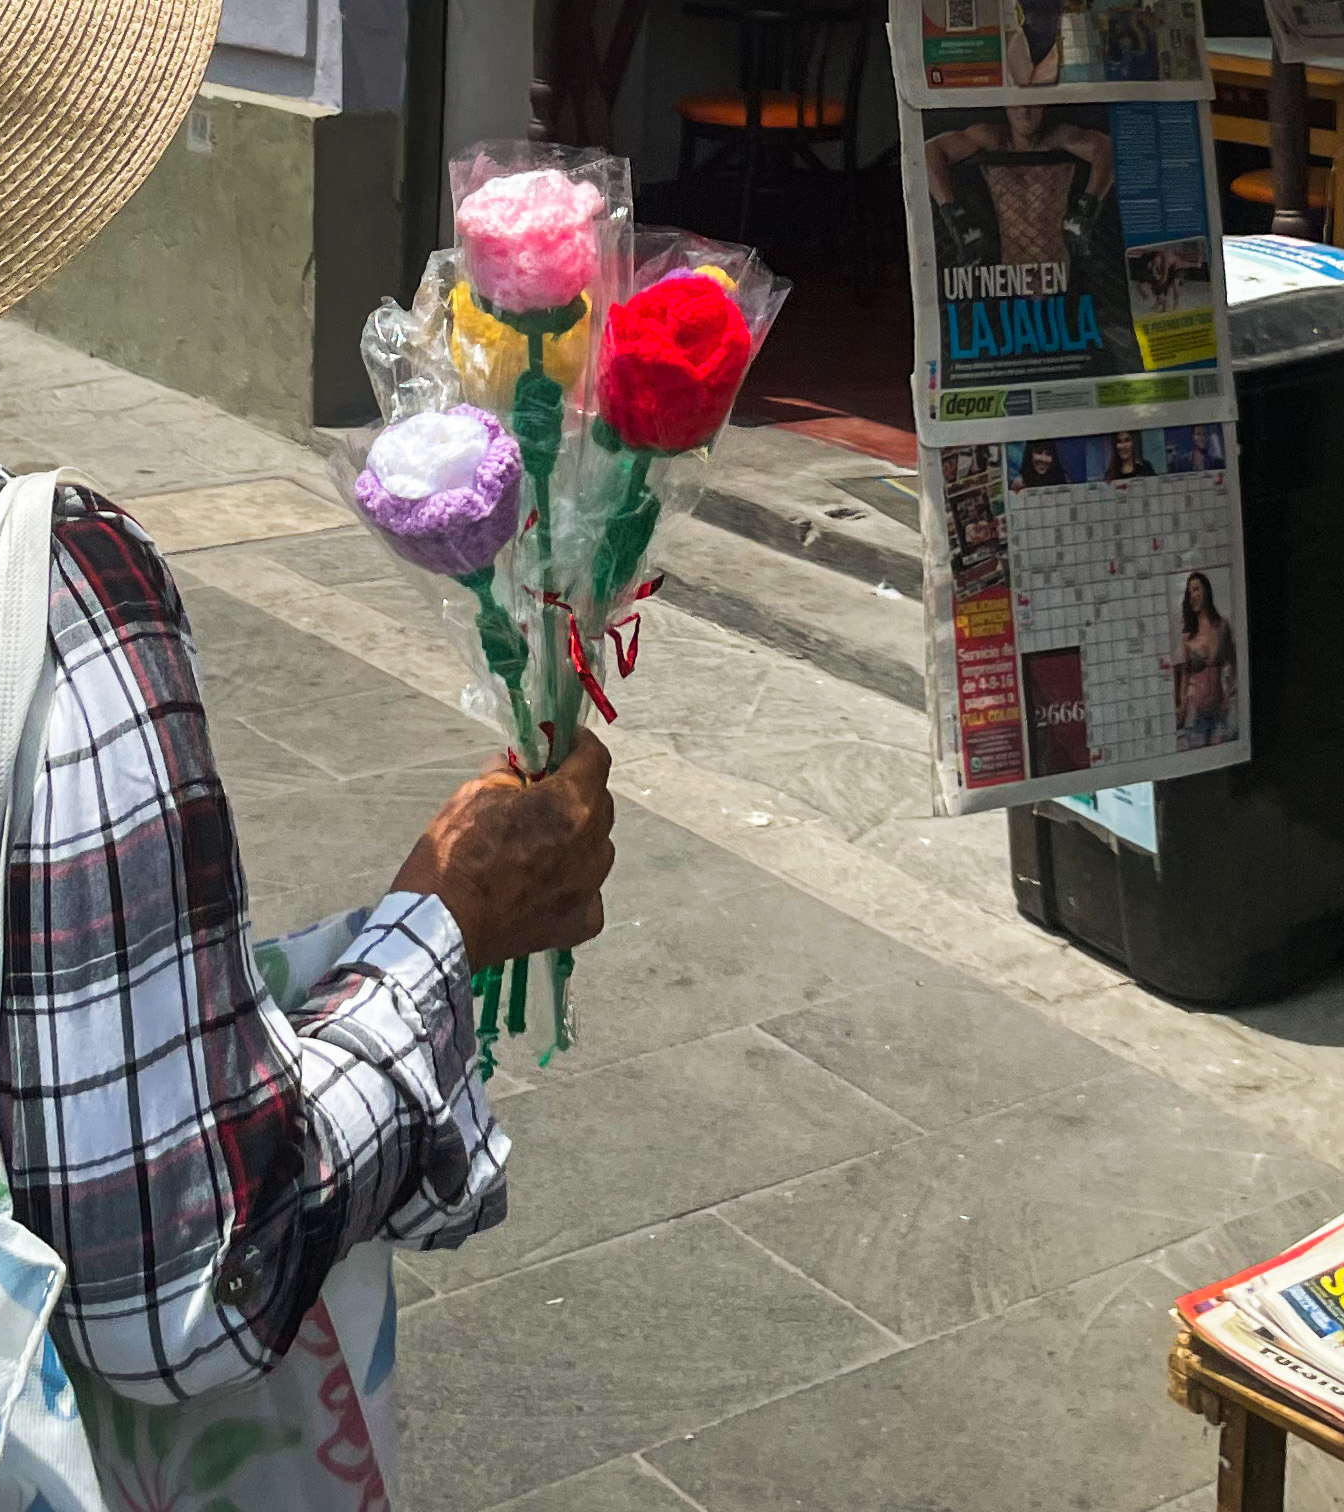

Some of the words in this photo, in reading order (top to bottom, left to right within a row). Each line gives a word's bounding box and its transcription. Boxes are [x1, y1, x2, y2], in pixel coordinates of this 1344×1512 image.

[943, 266, 973, 300] UN
[1040, 262, 1067, 295] EN
[947, 302, 999, 360] LA
[1000, 294, 1104, 357] JAULA
[946, 394, 994, 417] depor
[1035, 701, 1085, 728] 2666
